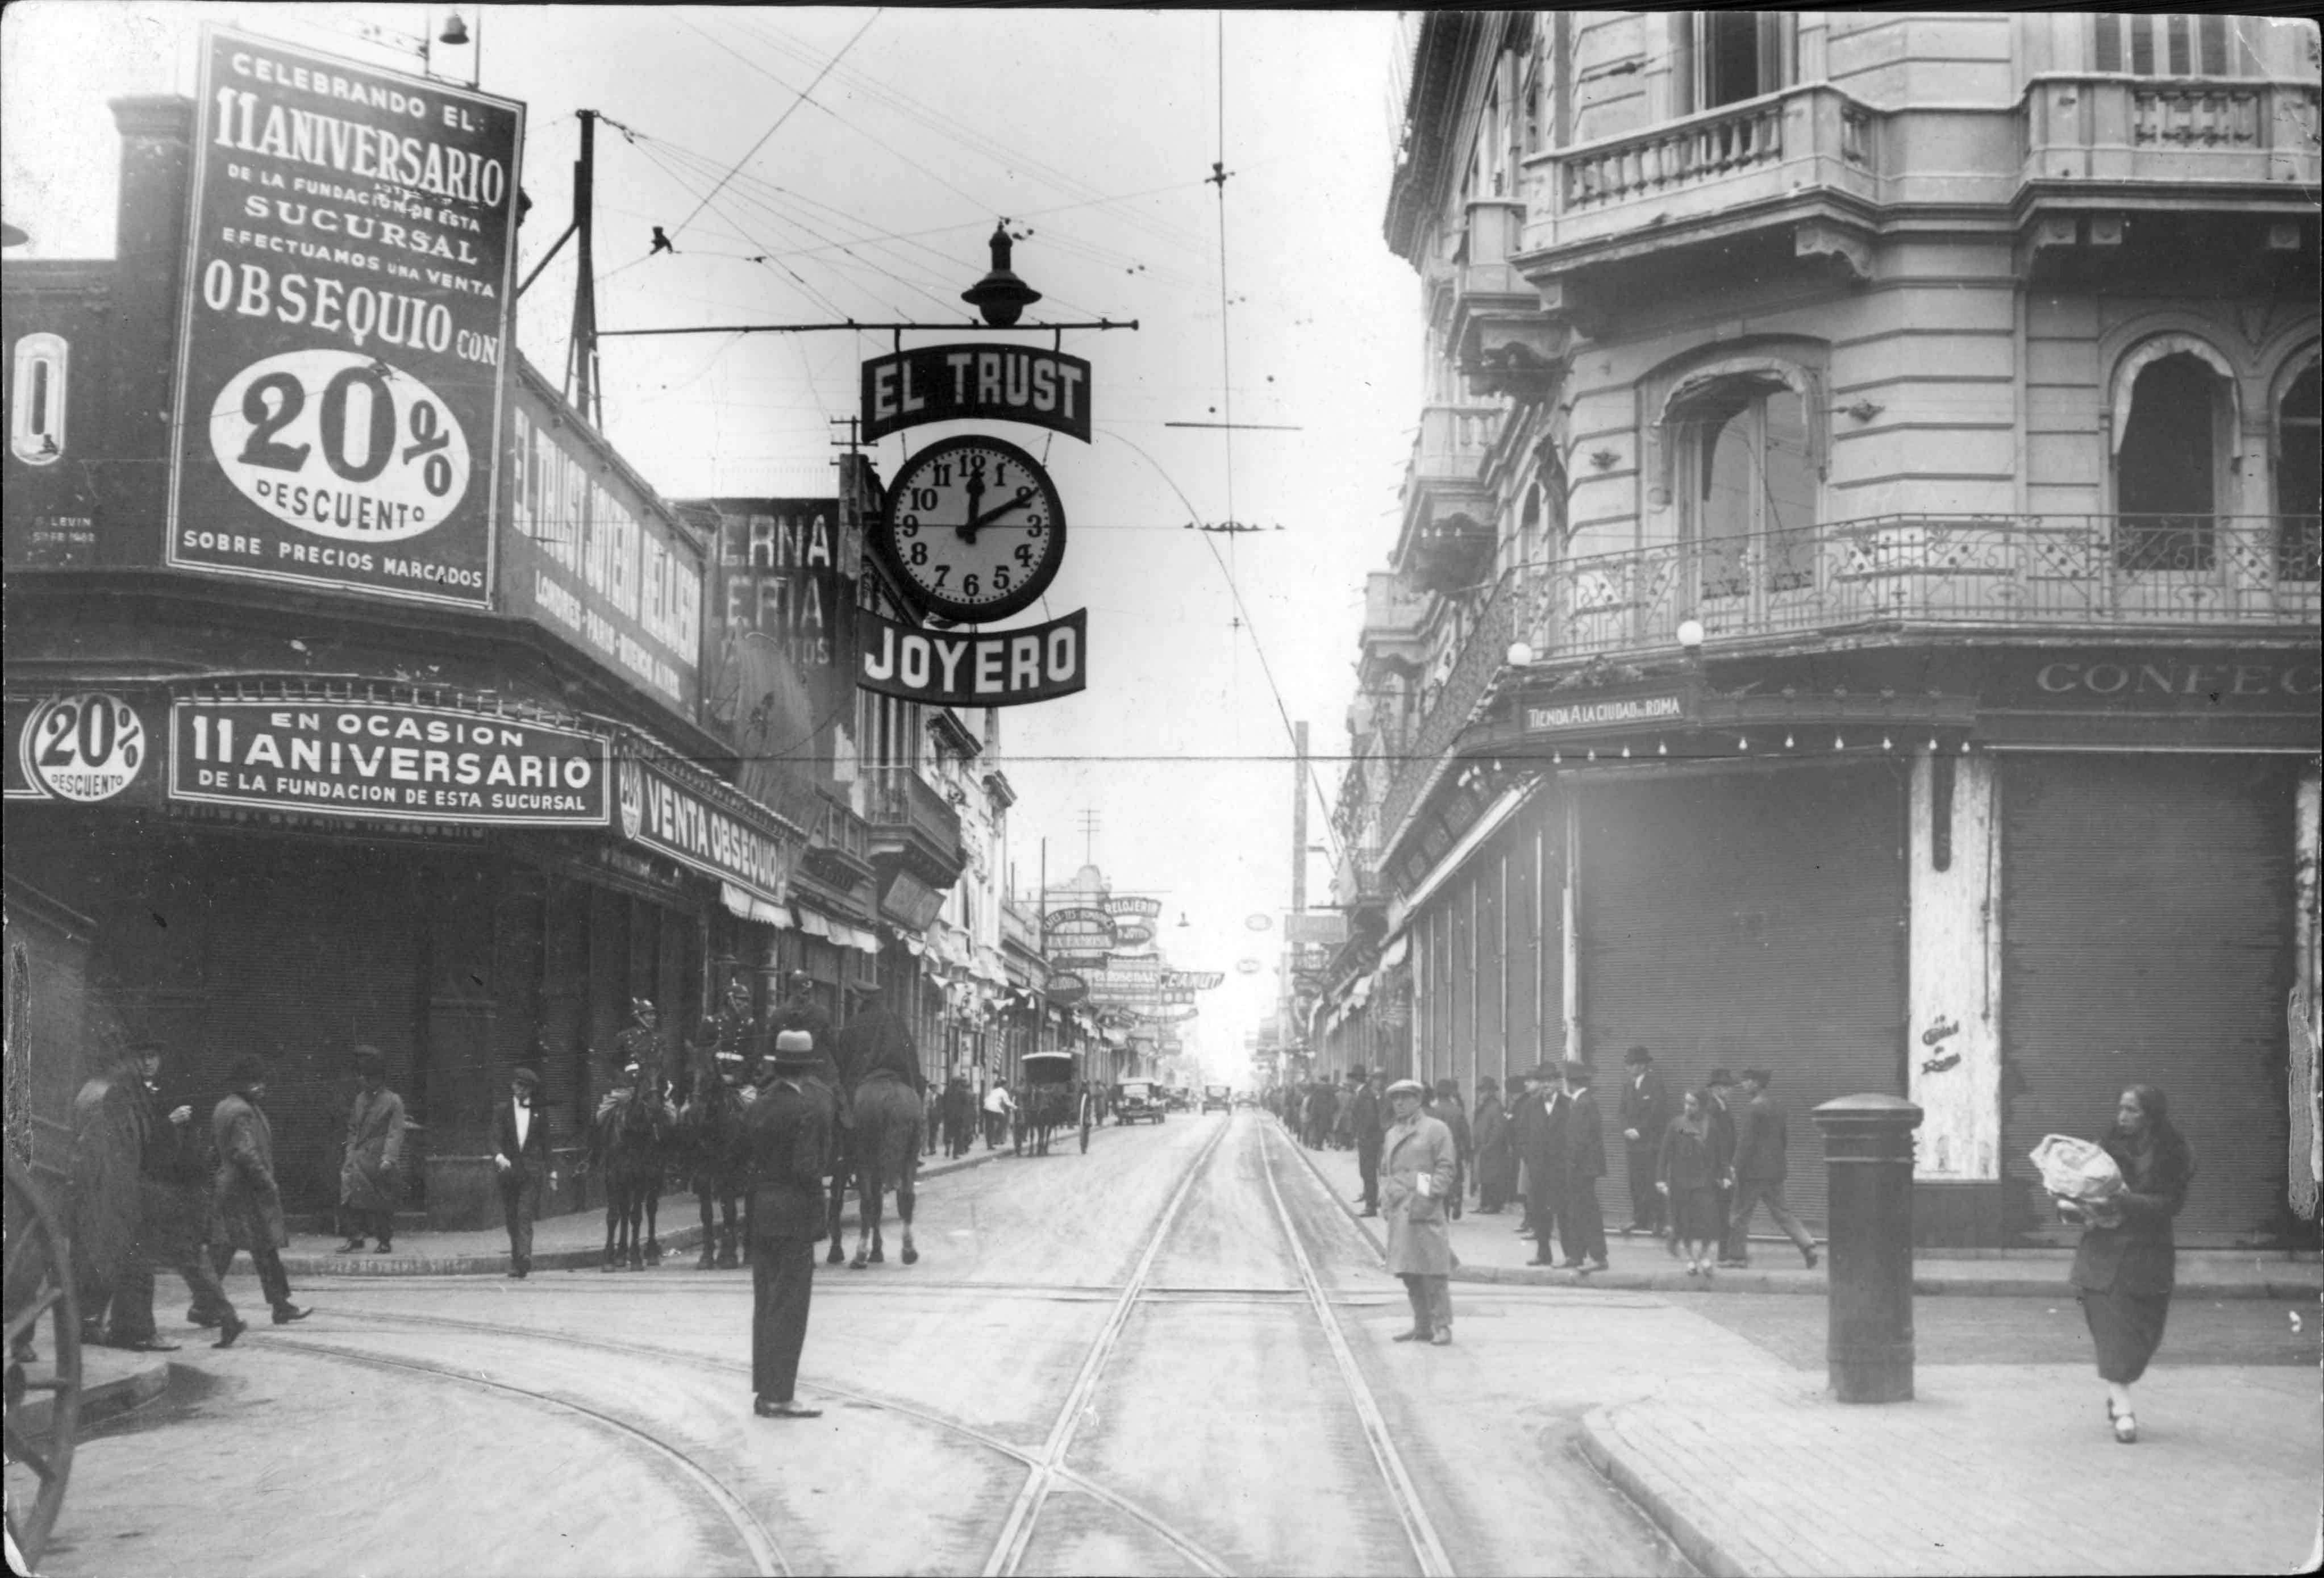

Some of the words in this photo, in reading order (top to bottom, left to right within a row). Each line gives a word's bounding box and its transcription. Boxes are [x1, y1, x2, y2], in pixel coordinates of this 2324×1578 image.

[232, 52, 426, 118] CELEBRANDO
[257, 106, 503, 207] ANIVERSARIO
[228, 163, 251, 178] DE
[261, 169, 284, 188] LA
[294, 177, 406, 214] FUNDACION
[411, 206, 432, 220] DE
[438, 210, 481, 233] ESTA
[244, 195, 477, 265] SUCURSAL
[223, 228, 380, 270] EFECTUAMOS
[388, 263, 419, 281] UNA
[426, 269, 495, 298] VENTA
[203, 259, 452, 352] OBSEQUIO
[457, 328, 499, 365] CON
[874, 359, 924, 422] EL
[947, 353, 1082, 419] TRUST
[237, 367, 452, 497] 20%
[933, 464, 952, 487] 11
[959, 455, 986, 477] 12
[995, 463, 1006, 486] 1
[256, 479, 424, 530] DESCUENTO
[910, 488, 938, 511] 10
[1015, 486, 1032, 509] 2
[902, 514, 919, 538] 9
[1027, 514, 1043, 538] 3
[184, 531, 261, 555] SOBRE
[279, 542, 373, 571] PRECIOS
[384, 557, 482, 588] MARCADOS
[910, 542, 928, 566] 8
[1014, 543, 1034, 567] 4
[934, 565, 951, 587] 7
[963, 573, 979, 597] 6
[993, 565, 1010, 589] 5
[864, 626, 1077, 694] JOYERO
[2036, 663, 2321, 695] CONFEC
[1528, 709, 1568, 728] TIENDA
[1596, 701, 1636, 721] CIUDAD
[1646, 697, 1680, 715] ROMA
[39, 695, 138, 769] 20%
[271, 713, 319, 731] EN
[337, 713, 523, 747] OCASION
[193, 715, 233, 763] 11
[244, 734, 591, 789] ANIVERSARIO
[51, 773, 123, 796] DESCUENTO
[199, 769, 229, 787] DE
[238, 773, 267, 792] LA
[277, 777, 396, 802] FUNDACION
[406, 789, 427, 805] DE
[435, 790, 482, 808] ESTA
[492, 794, 586, 810] SUCURSAL
[646, 773, 709, 857] VENTA
[711, 813, 777, 888] OBSEQUIO
